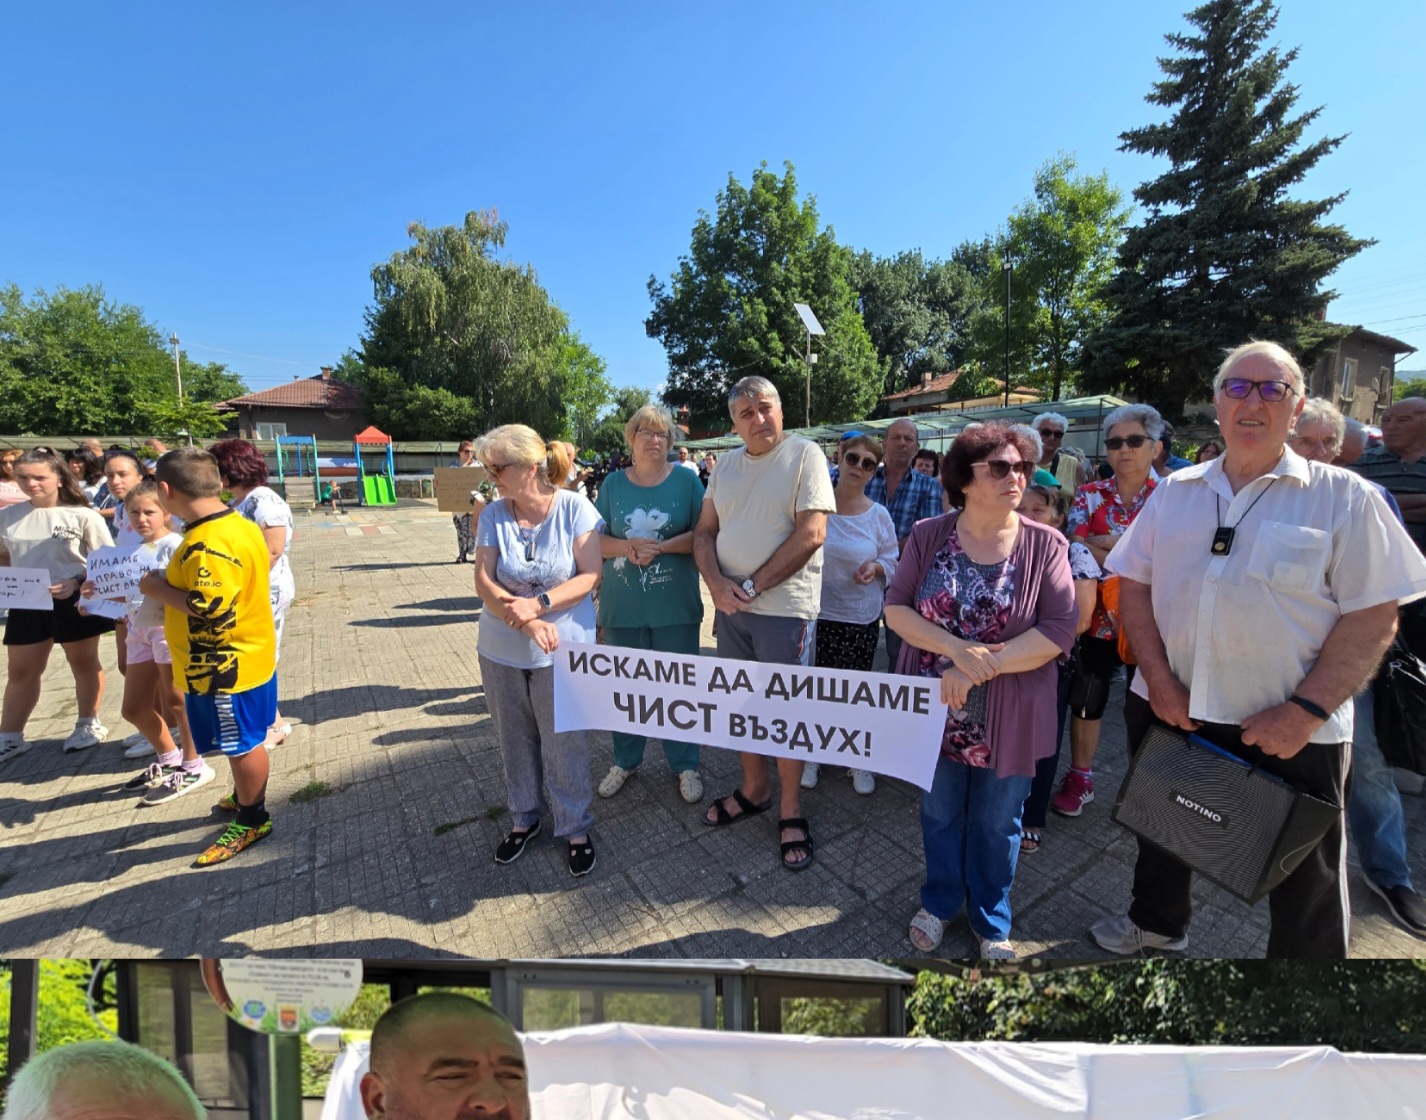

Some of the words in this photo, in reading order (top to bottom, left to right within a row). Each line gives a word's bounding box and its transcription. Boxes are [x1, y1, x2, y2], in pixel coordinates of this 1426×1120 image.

[90, 555, 139, 571] ИМАМЕ
[95, 569, 133, 584] ПРАВО
[568, 650, 696, 687] ИСКАМЕ
[708, 666, 755, 694] ДА
[764, 672, 931, 715] ДИШАМЕ
[613, 691, 718, 733] ЧИСТ
[729, 713, 872, 758] ВЪЗДУХ!
[1176, 795, 1222, 822] NOTINO
